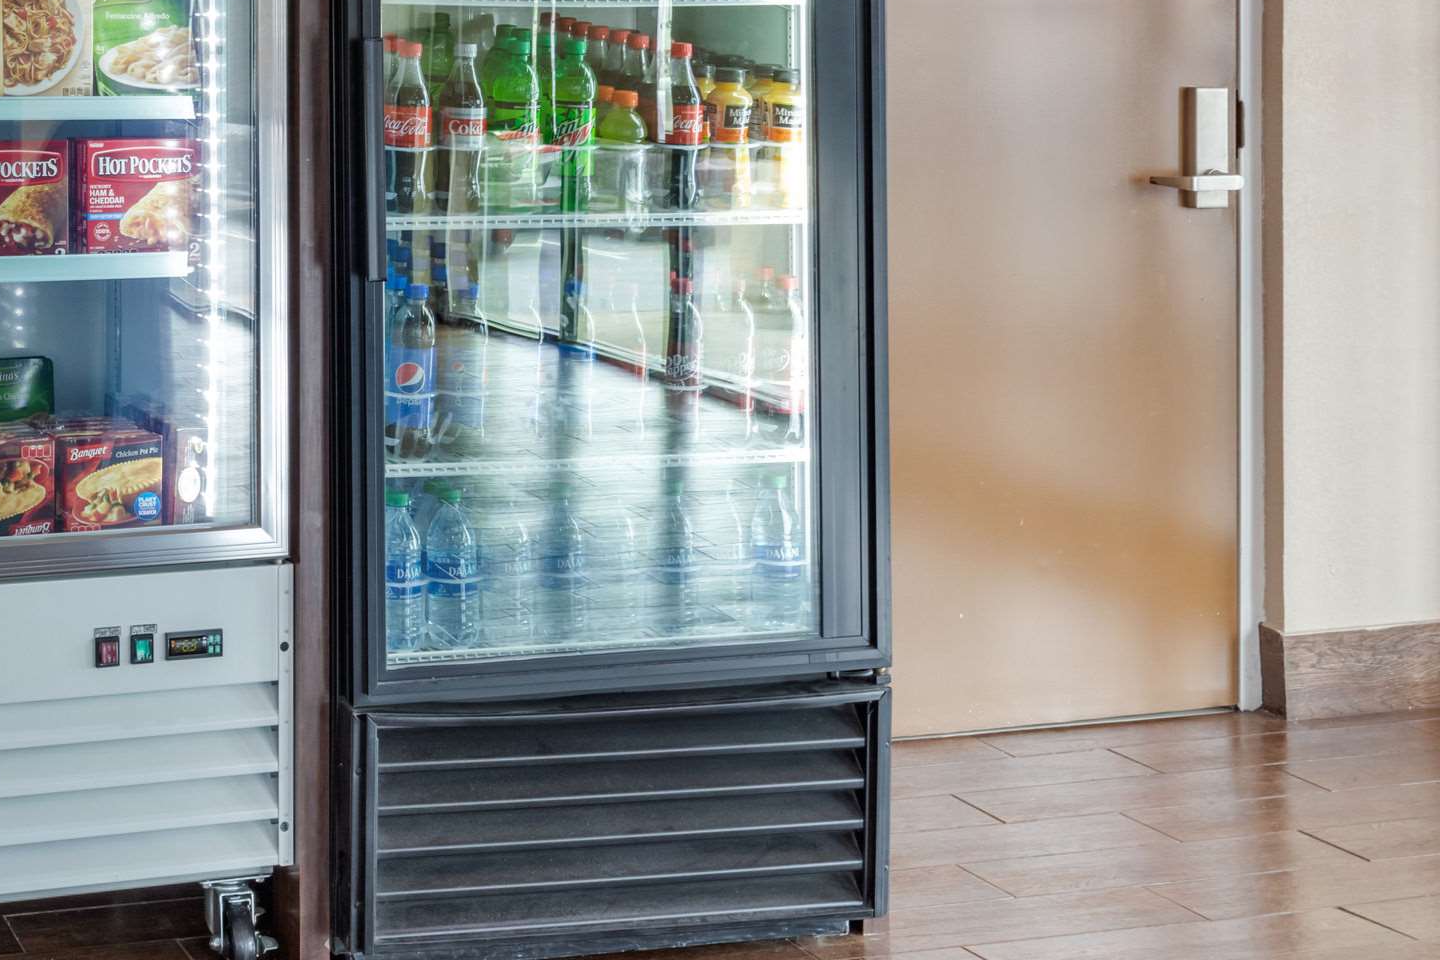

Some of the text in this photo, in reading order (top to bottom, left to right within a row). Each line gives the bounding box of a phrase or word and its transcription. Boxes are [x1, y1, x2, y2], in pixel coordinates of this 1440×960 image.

[448, 119, 484, 137] Coke
[97, 156, 129, 176] HOT
[89, 189, 108, 197] HAM
[89, 196, 125, 205] CHEDDAR
[70, 446, 107, 461] Banquet
